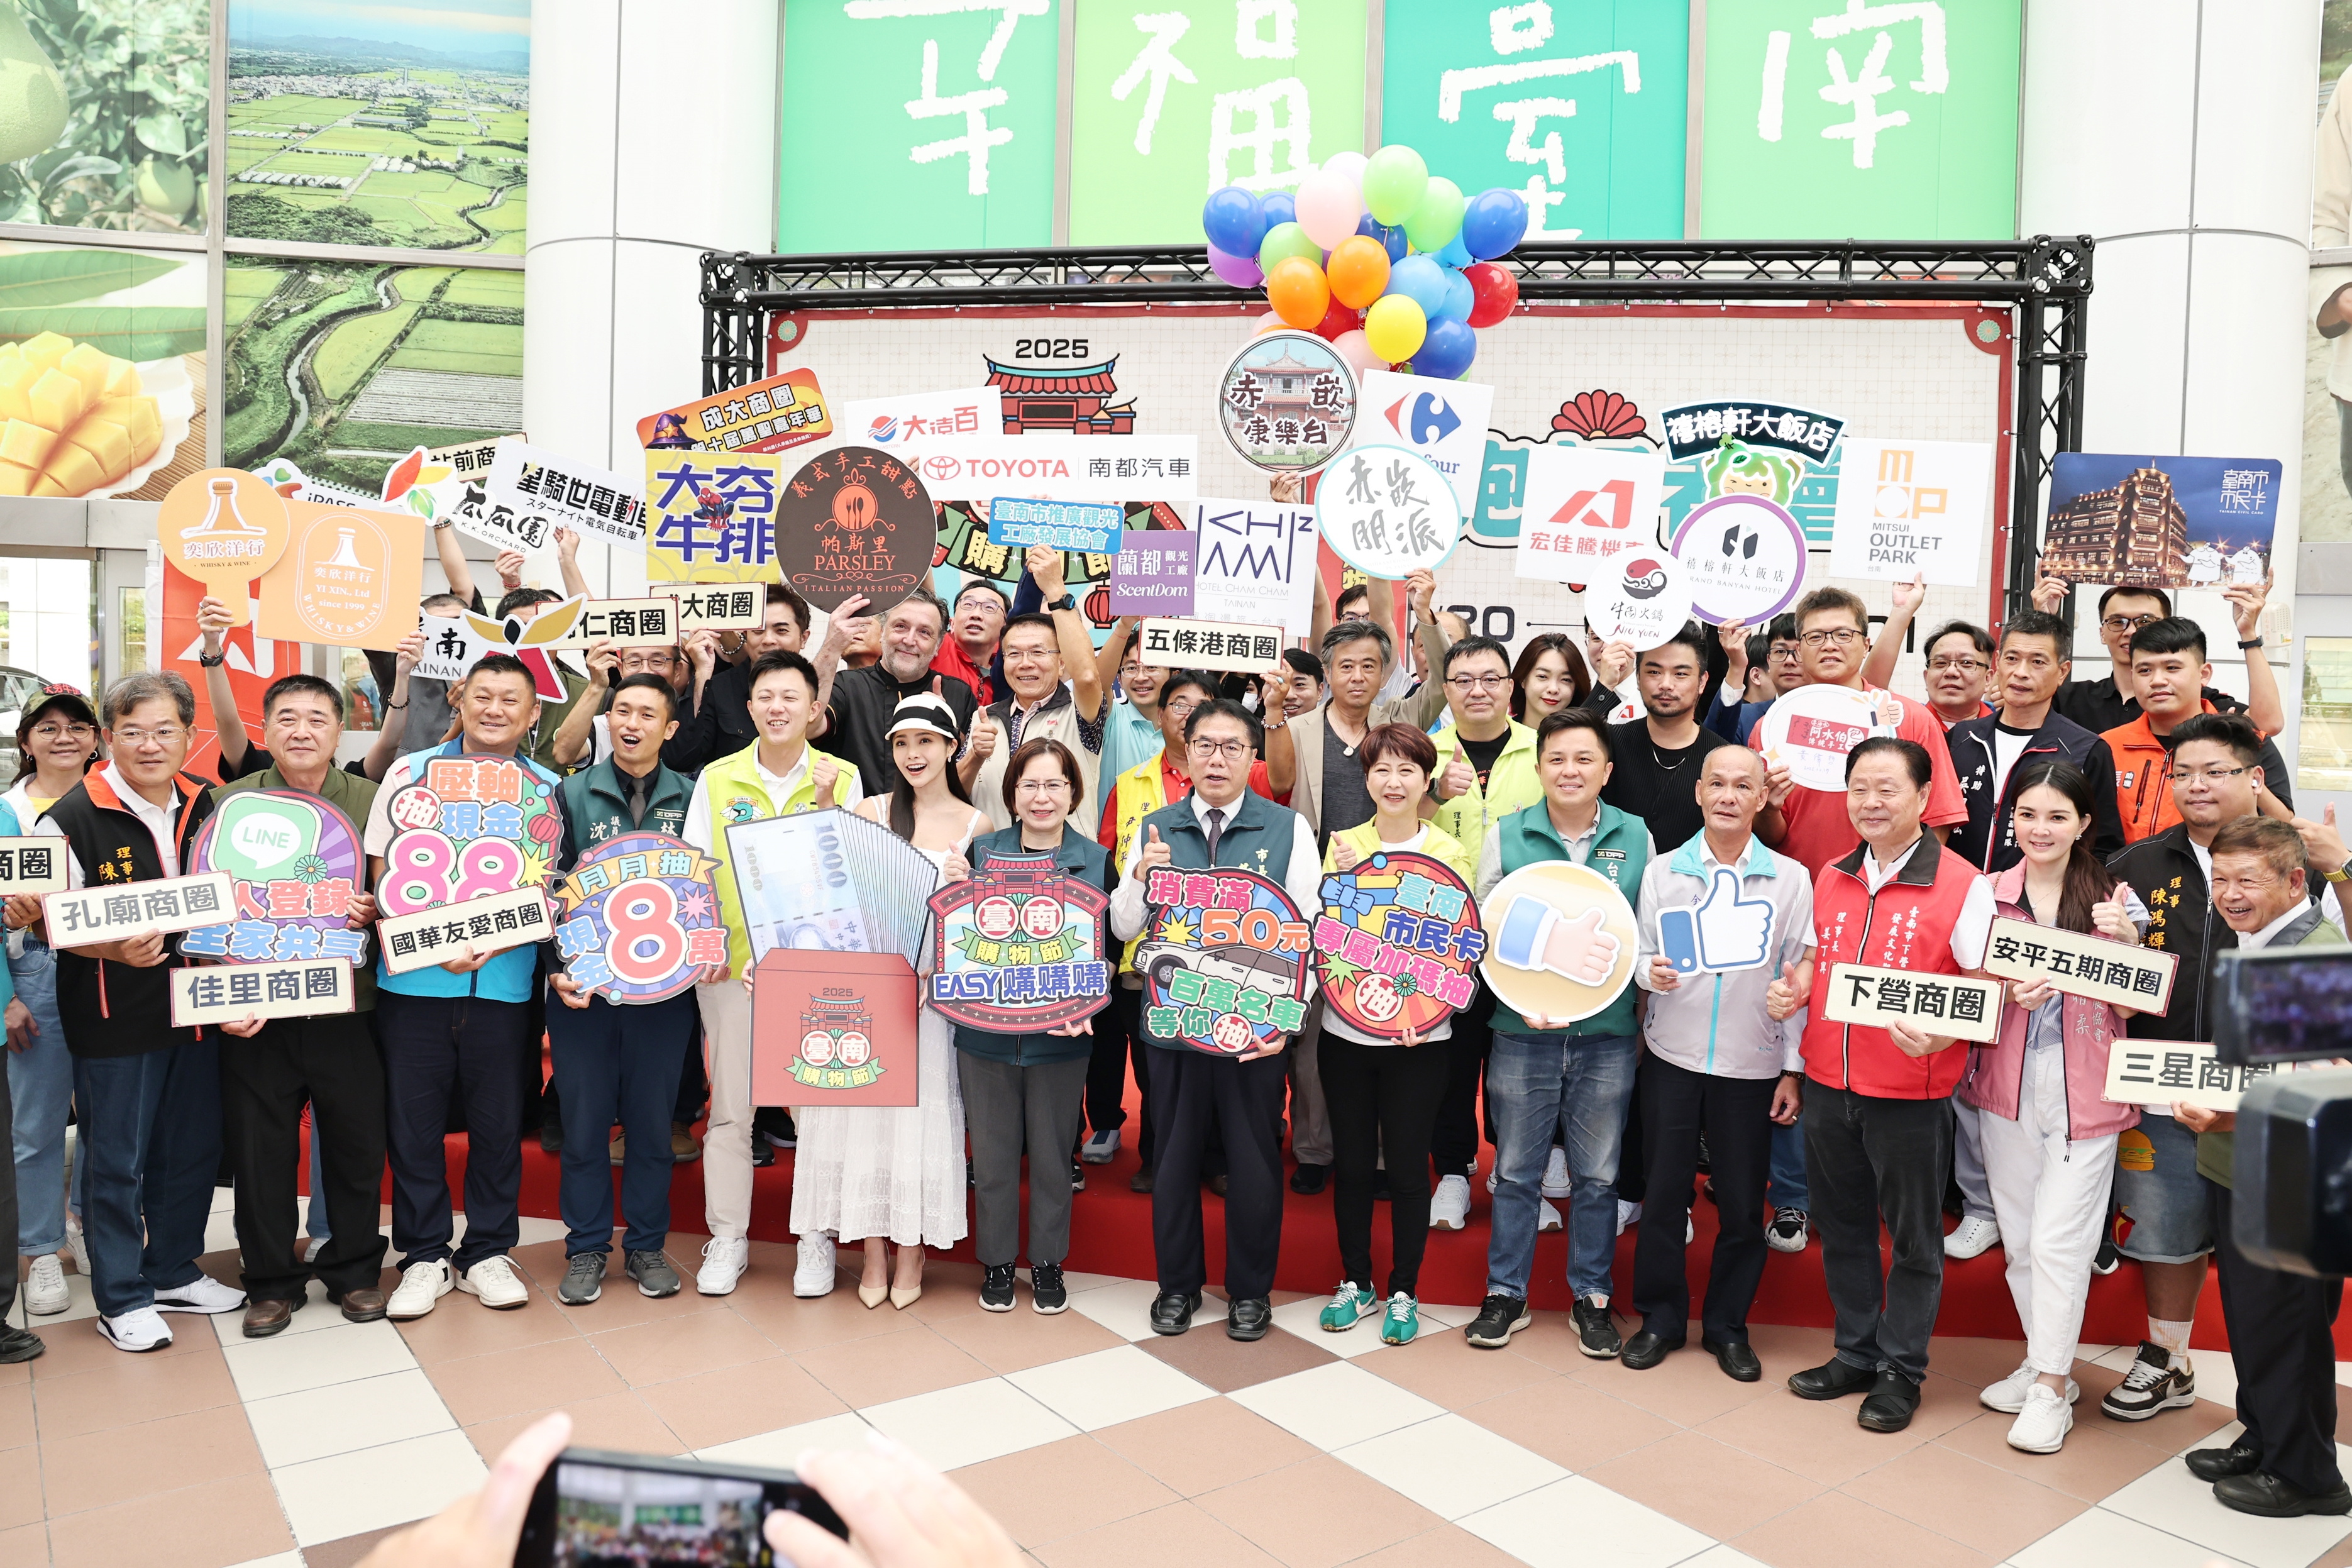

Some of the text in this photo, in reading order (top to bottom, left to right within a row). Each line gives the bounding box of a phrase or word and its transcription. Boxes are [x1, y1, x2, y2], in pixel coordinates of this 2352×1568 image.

[1015, 338, 1090, 360] 2025
[700, 384, 795, 431] 成大商圈
[1244, 417, 1329, 445] 康樂台
[1665, 407, 1836, 451] 禧榕軒大飯店
[431, 446, 495, 472] 前商
[966, 457, 1191, 478] TOYOTA 南都汽車
[791, 451, 918, 499] 義式手工甜點
[994, 500, 1119, 529] 臺南市推廣觀光
[1872, 522, 1909, 532] MITSUI
[184, 539, 265, 559] 奕欣洋行
[820, 533, 888, 555] 帕斯里
[1001, 523, 1109, 551] 工廠發展協會
[1870, 533, 1942, 550] OUTLET
[814, 555, 896, 571] PARSLEY
[1117, 549, 1161, 576] 蘭都
[1164, 550, 1189, 562] 觀光
[1686, 556, 1786, 583] 禧榕軒大飯店
[1869, 548, 1917, 565] PARK
[314, 566, 372, 584] 奕欣洋行
[1164, 565, 1189, 577] 工廠
[1689, 575, 1782, 595] RAND BANYAN HOTEL
[316, 584, 326, 593] YI
[355, 590, 370, 599] Ltd
[805, 584, 904, 592] ITALIAN PASSION
[1116, 582, 1189, 597] ScentDom
[303, 593, 381, 633] WHISKY & WINE
[318, 599, 365, 612] since 1999
[669, 590, 753, 620] 大商圈
[567, 609, 667, 641] 仁商圈
[1605, 624, 1660, 638] NIU YUEN
[1146, 629, 1277, 661] 五條港商圈
[411, 665, 461, 678] AINAN
[1809, 726, 1847, 743] 阿水伯
[429, 759, 522, 803] 壓軸
[1970, 765, 1986, 791] 特助
[399, 790, 524, 841] 抽 現金
[610, 815, 621, 836] 議員
[1453, 811, 1461, 838] 理事長
[241, 827, 291, 849] LINE
[744, 844, 763, 892] 1000
[814, 822, 847, 889] 1000
[1606, 851, 1625, 859] DPP
[384, 831, 522, 916] 88
[578, 852, 692, 895] 月月抽
[235, 878, 356, 920] 人登錄
[1149, 872, 1254, 912] 消費滿
[1396, 873, 1469, 920] 臺南
[2169, 876, 2182, 908] 理事
[61, 883, 220, 932] 孔廟商圈
[980, 900, 1059, 934] 臺南
[390, 902, 543, 957] 國華友愛商圈
[1200, 908, 1311, 953] 50元
[1382, 910, 1488, 963] 市民卡
[1831, 911, 1847, 953] 理事長
[557, 915, 614, 992] 現金
[973, 937, 1064, 964] 購物節
[1313, 917, 1474, 1010] 專屬加碼抽
[1994, 935, 2163, 998] 安平五期商圈
[187, 966, 339, 1008] 佳里商圈
[822, 988, 853, 998] 2025
[1169, 969, 1306, 1032] 百萬名車
[1359, 979, 1399, 1017] 抽
[1844, 974, 1988, 1024] 下營商圈
[1149, 1007, 1250, 1049] 等你 抽
[805, 1035, 867, 1062] 臺南
[801, 1067, 869, 1088] 購物節
